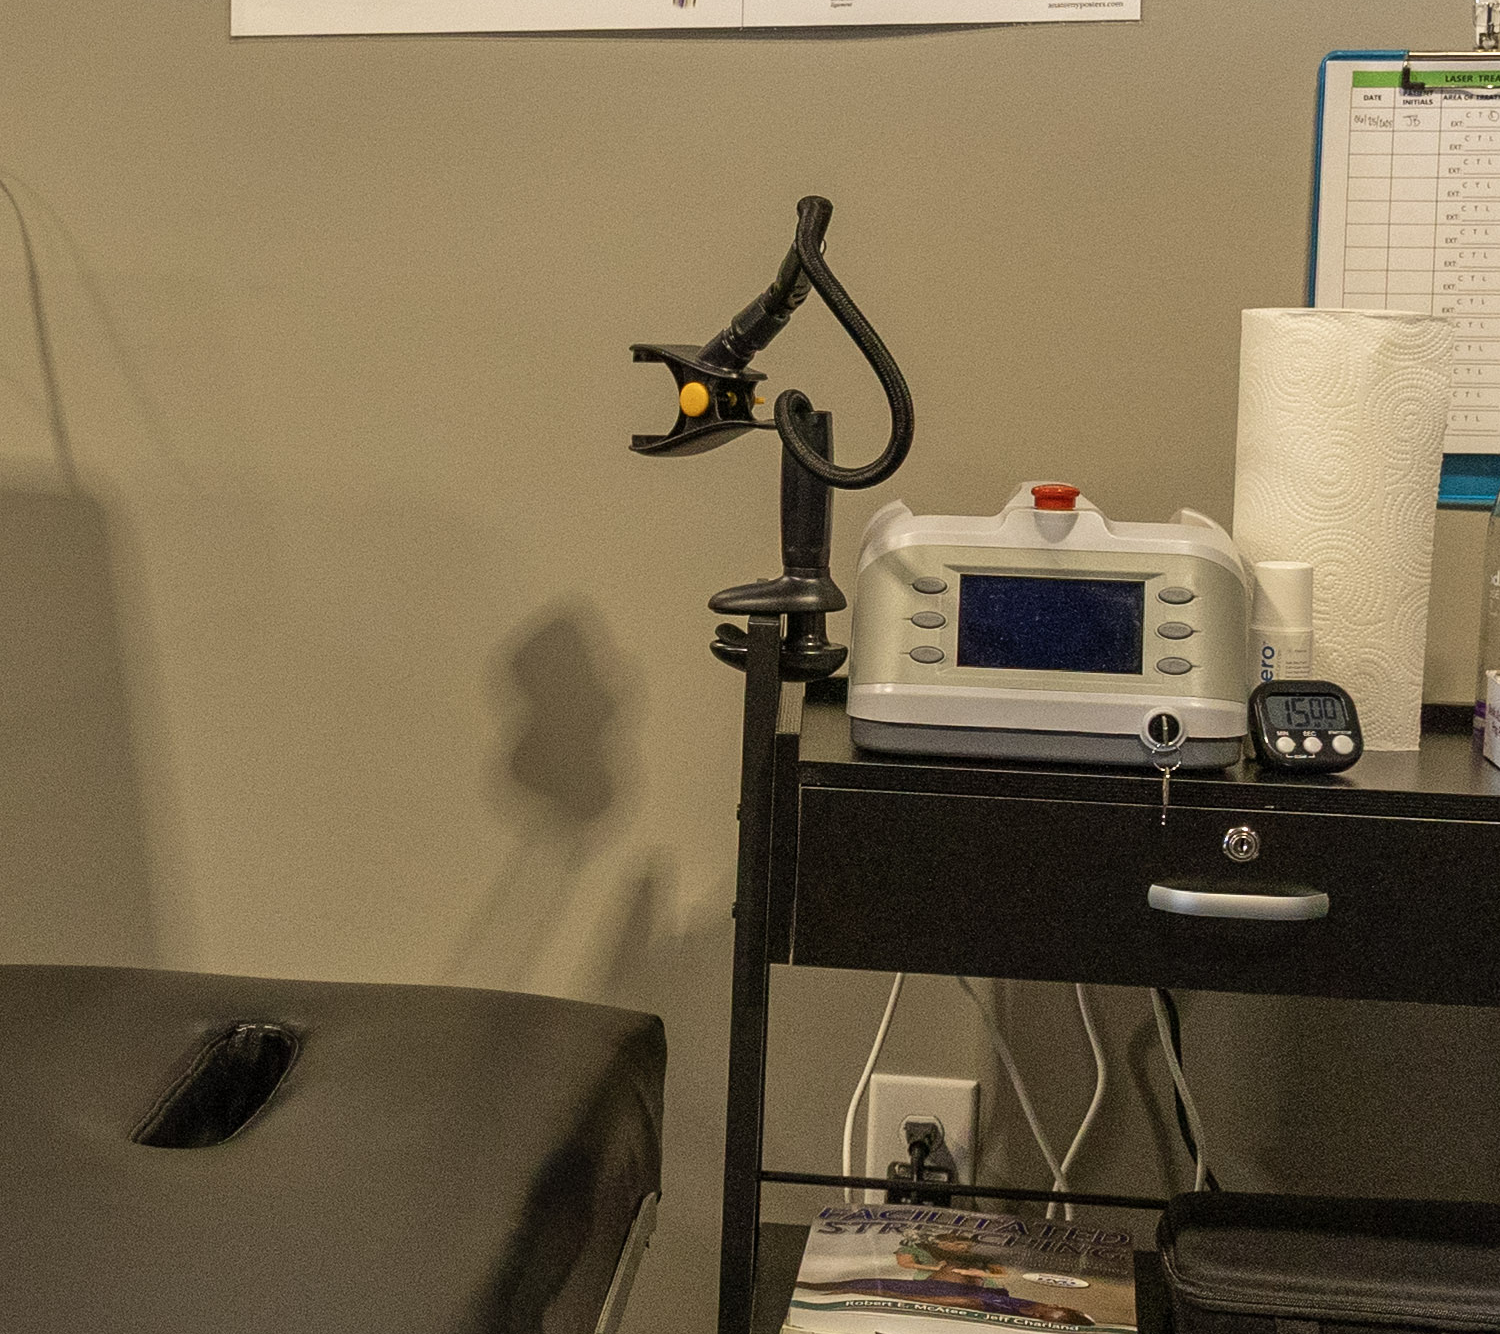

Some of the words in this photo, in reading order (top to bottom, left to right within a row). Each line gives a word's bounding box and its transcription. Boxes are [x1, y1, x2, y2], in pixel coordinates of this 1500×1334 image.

[1048, 1, 1123, 9] anatomyposters.com
[1445, 74, 1473, 83] LASER
[819, 1207, 1131, 1245] FACILITATED
[845, 1300, 893, 1308] Robert
[914, 1305, 968, 1316] McAtee
[983, 1313, 1008, 1323] Jeff
[1013, 1318, 1080, 1332] Charland
